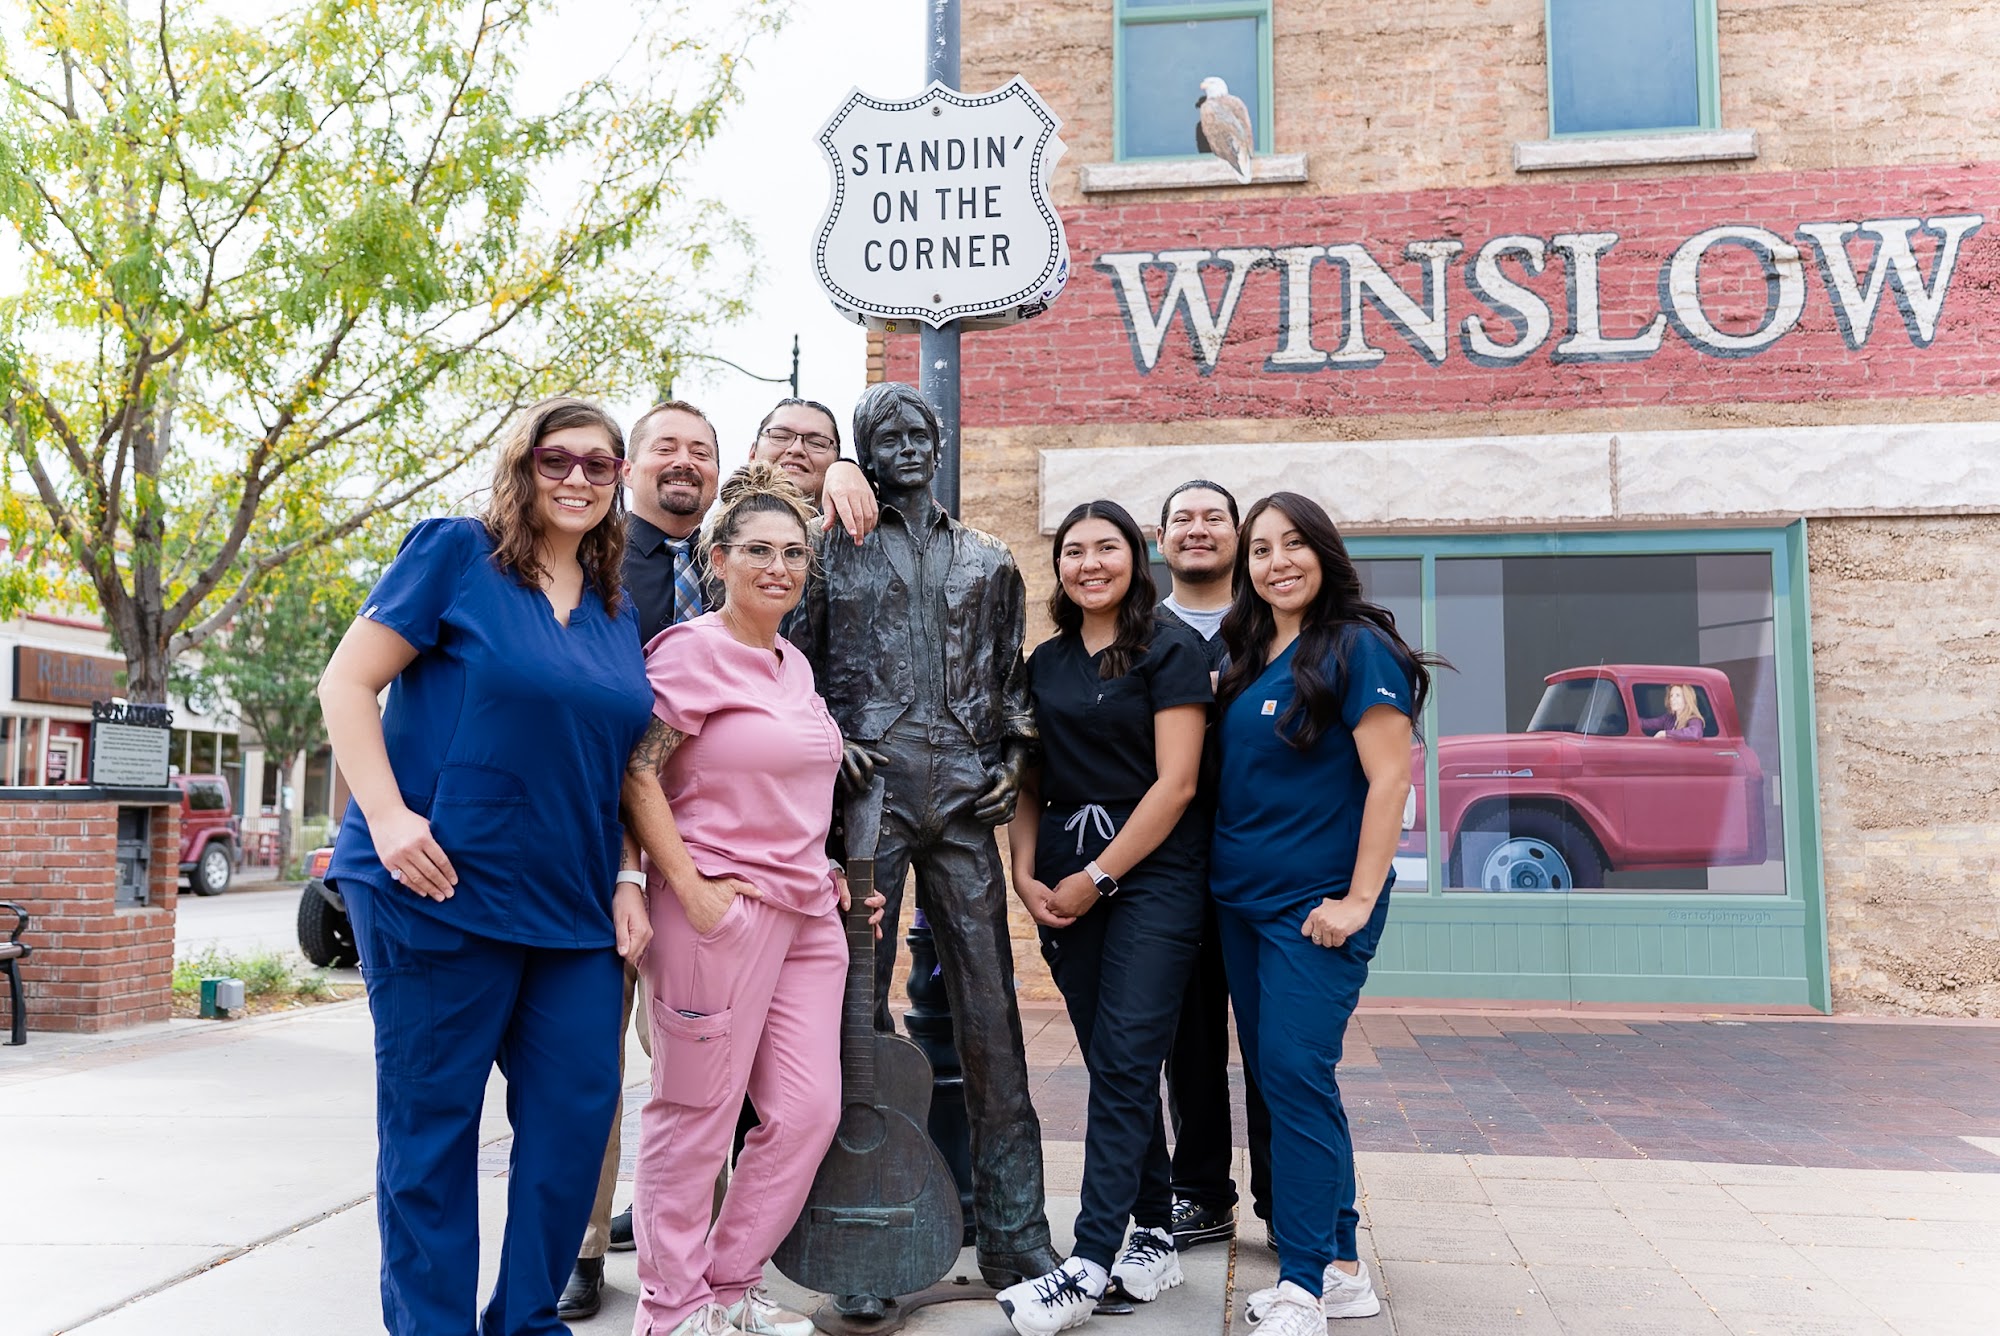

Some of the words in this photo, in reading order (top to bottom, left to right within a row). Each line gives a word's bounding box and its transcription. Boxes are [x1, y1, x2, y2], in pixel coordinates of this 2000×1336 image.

[851, 135, 1023, 176] STANDIN'
[872, 190, 918, 224] ON
[935, 185, 1002, 220] THE
[864, 234, 1010, 272] CORNER
[1095, 214, 1984, 377] WINSLOW
[92, 700, 174, 725] DONATIONS
